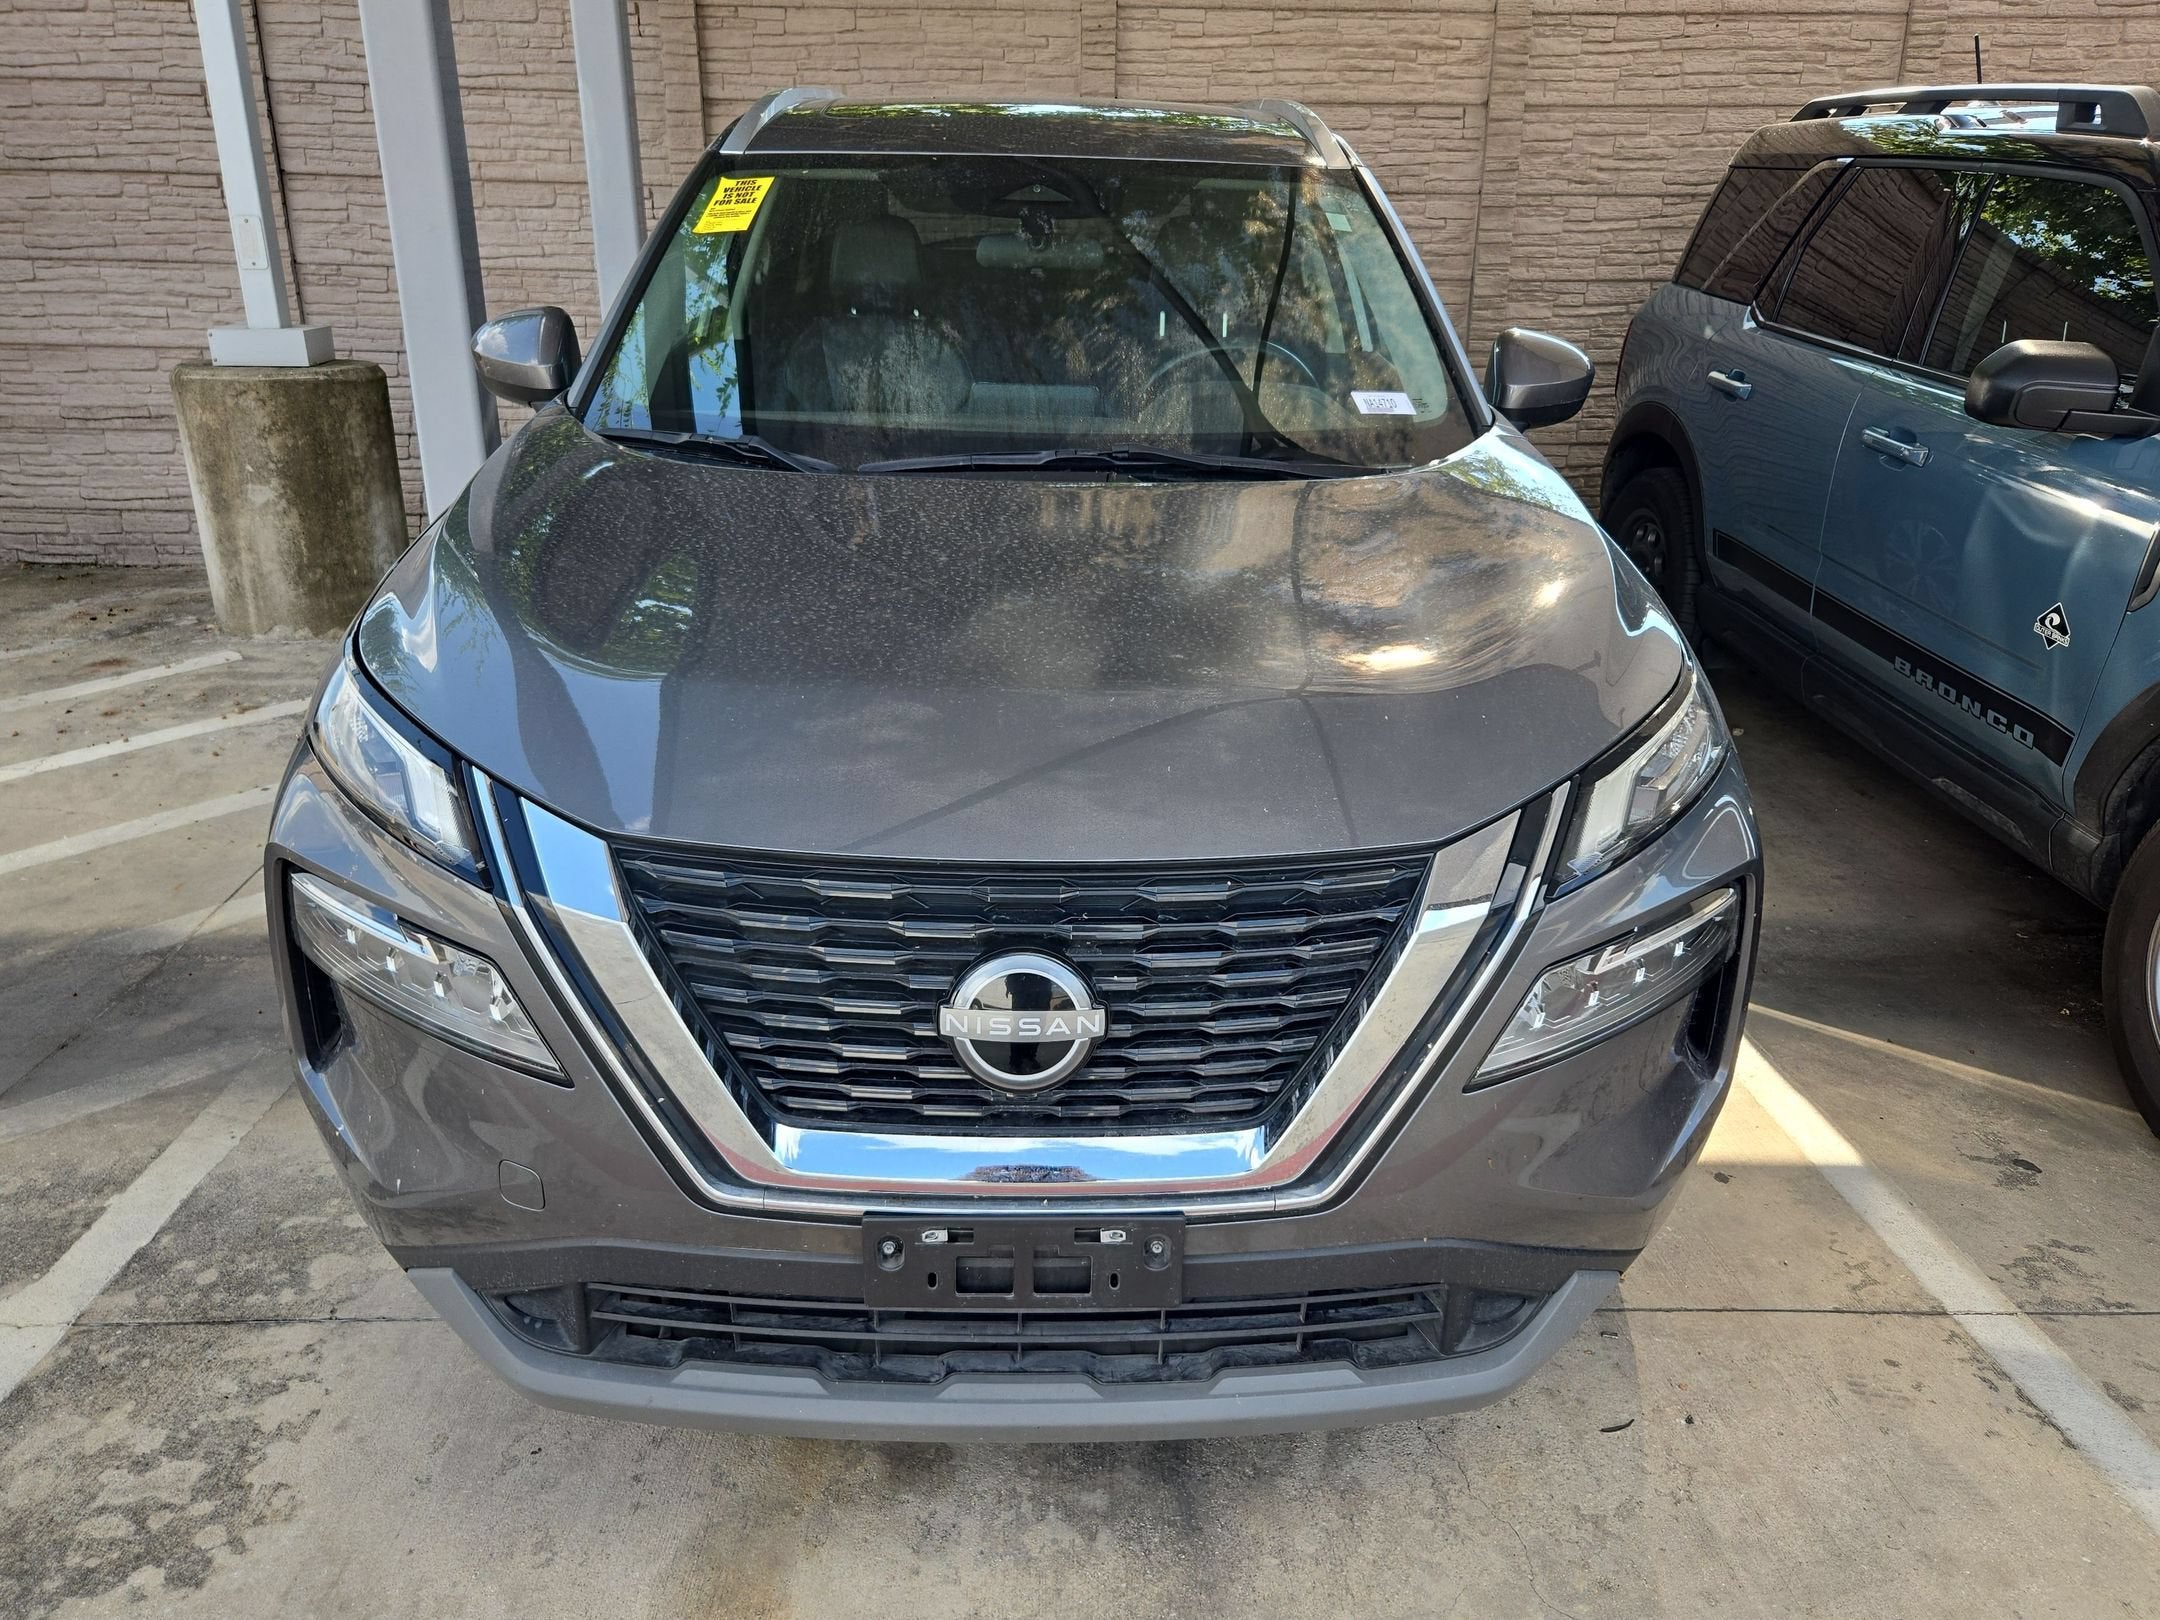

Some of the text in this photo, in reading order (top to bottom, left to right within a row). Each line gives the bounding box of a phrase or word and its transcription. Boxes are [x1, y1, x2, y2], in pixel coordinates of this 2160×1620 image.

[723, 185, 761, 193] VEHICLE
[2035, 625, 2069, 645] OUTER BANKS
[1894, 656, 2035, 749] BRONCO
[945, 1014, 1100, 1036] NISSAN
